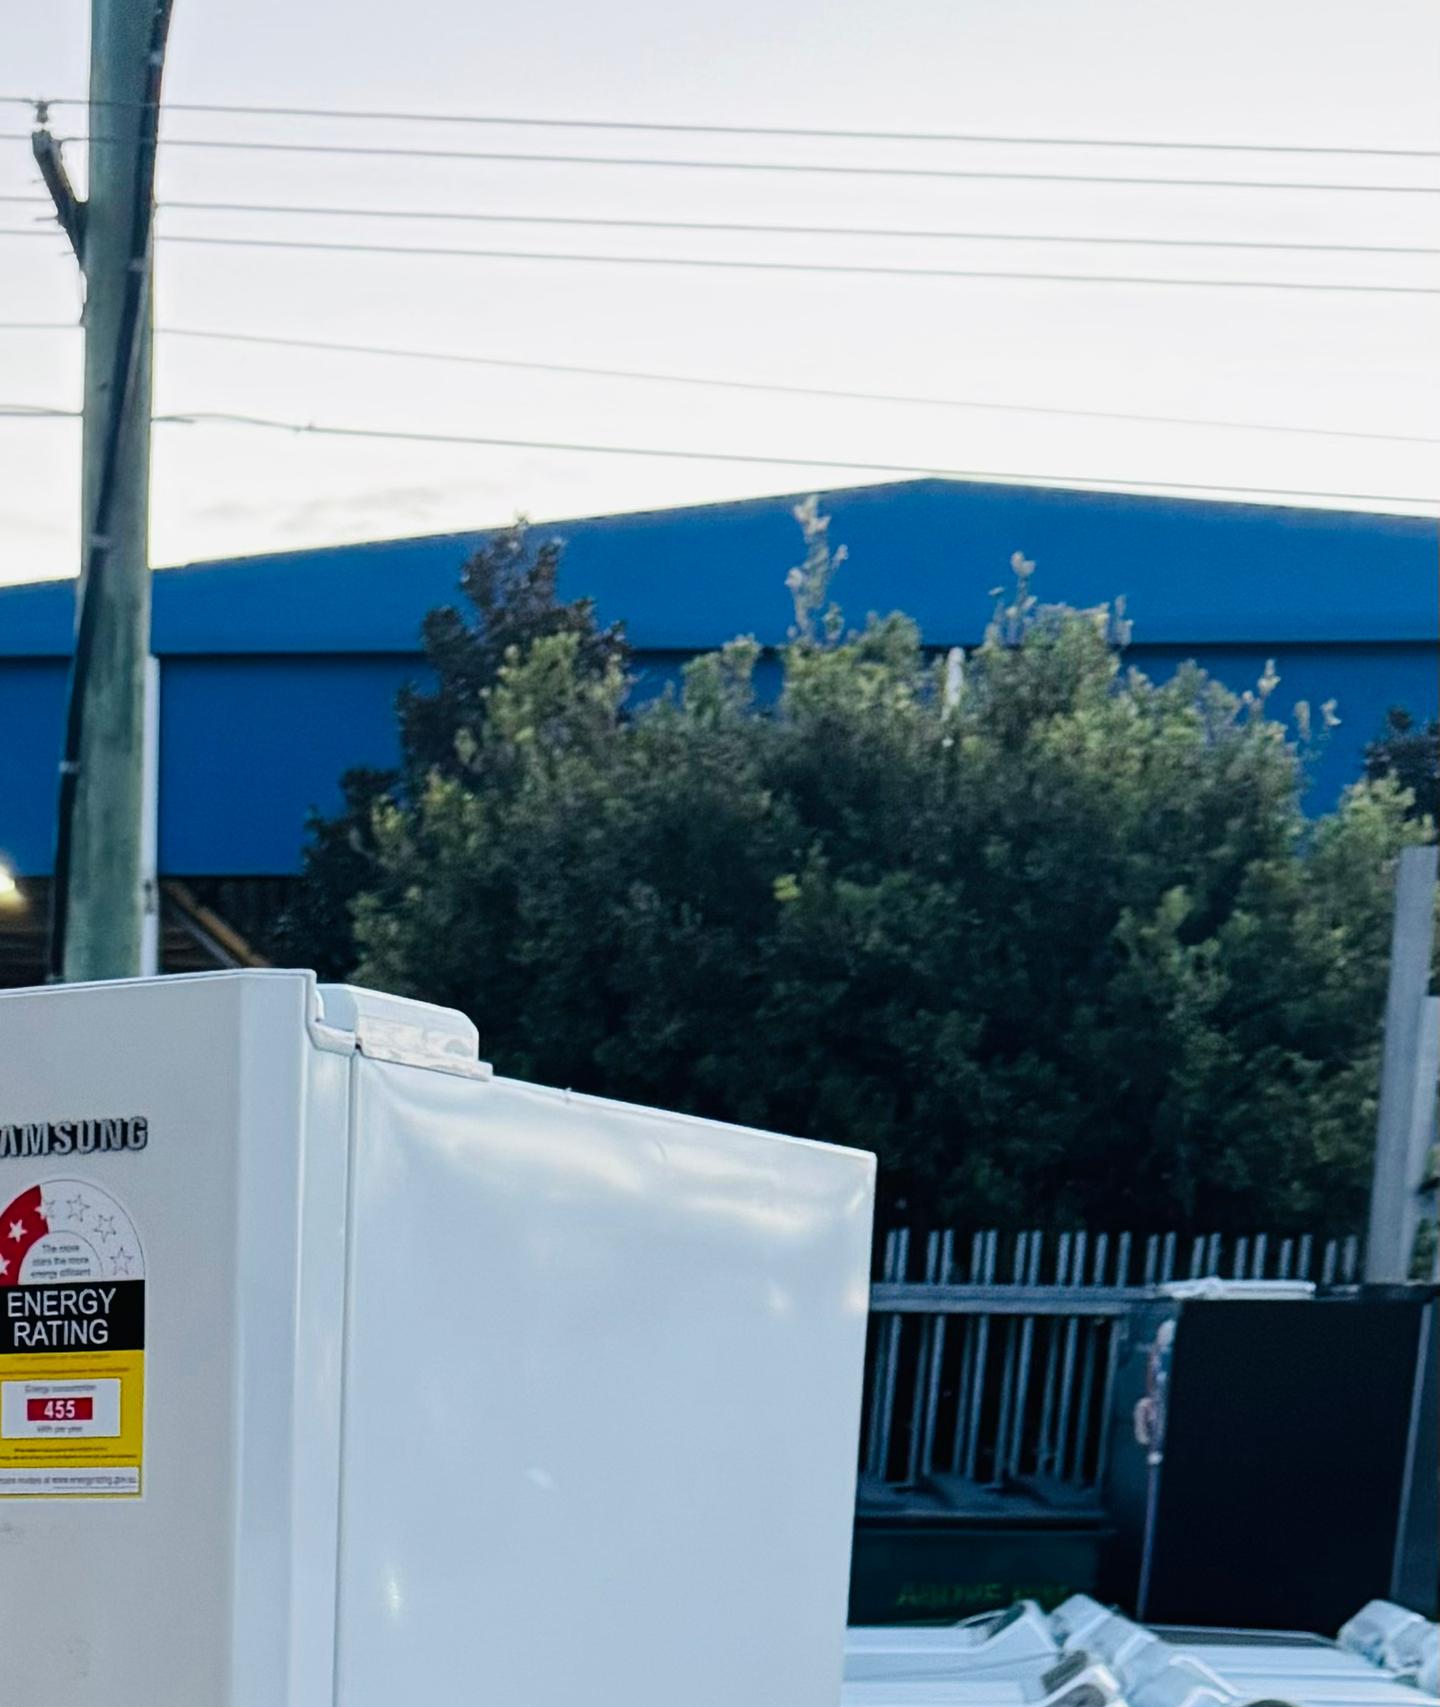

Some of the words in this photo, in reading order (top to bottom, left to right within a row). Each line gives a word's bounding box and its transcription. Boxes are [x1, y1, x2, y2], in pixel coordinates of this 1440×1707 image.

[7, 1288, 116, 1317] ENERGY
[13, 1319, 109, 1346] RATING
[44, 1400, 75, 1419] 455
